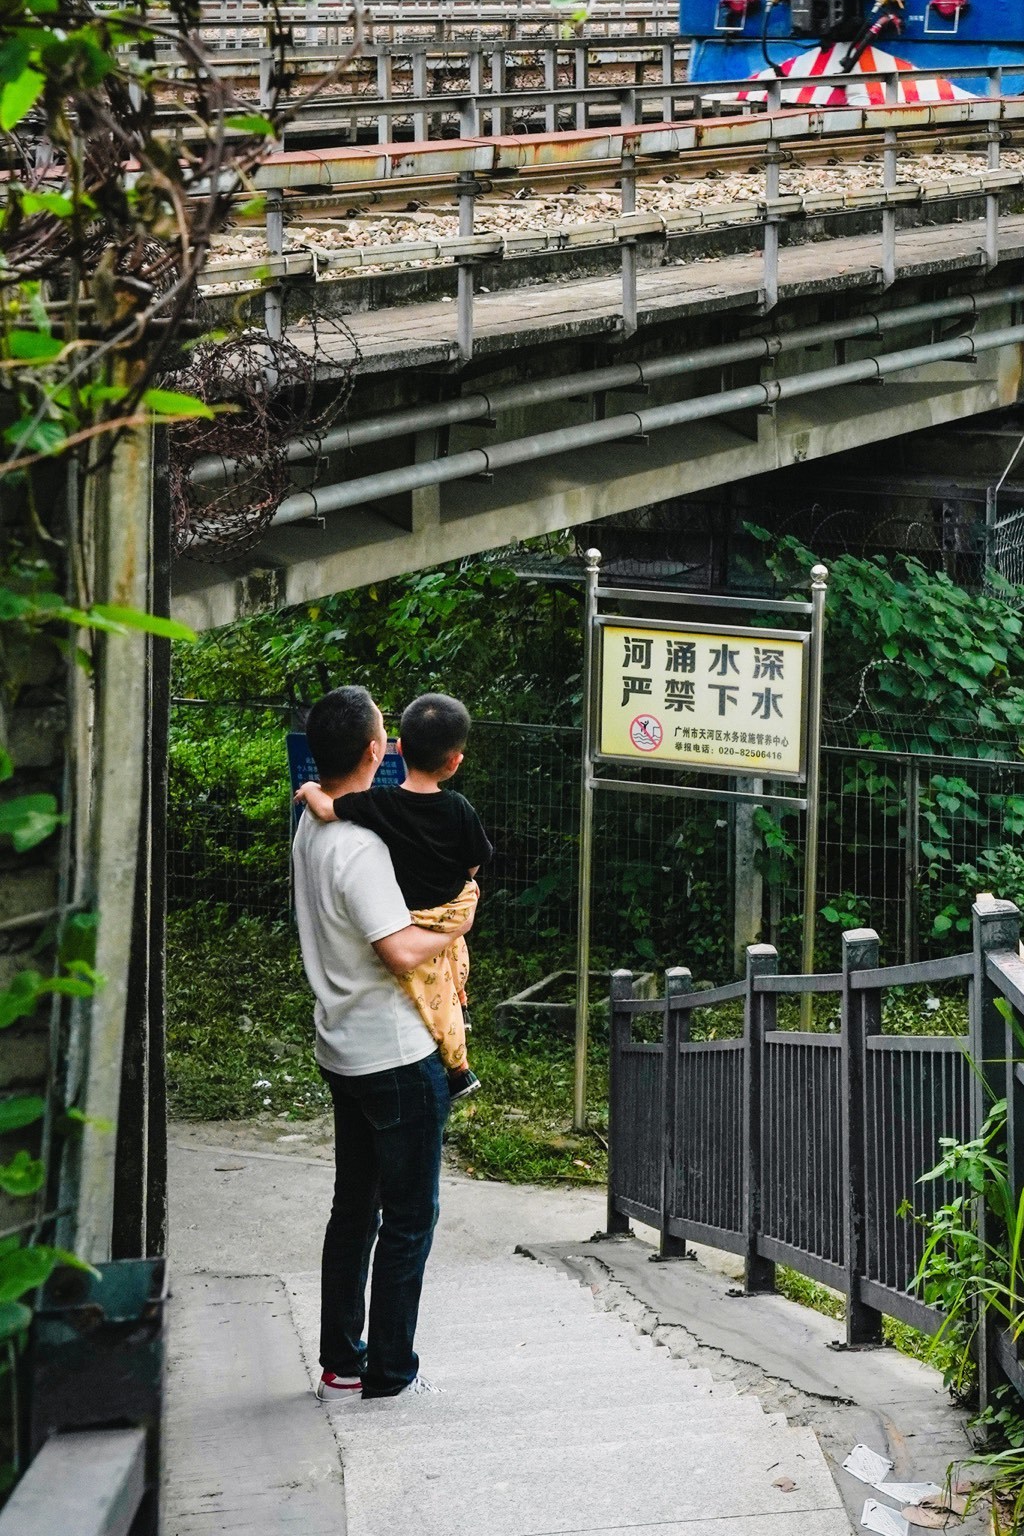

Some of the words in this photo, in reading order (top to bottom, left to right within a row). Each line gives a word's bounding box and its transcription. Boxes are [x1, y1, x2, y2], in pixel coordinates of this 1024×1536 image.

[622, 636, 785, 681] 河涌水深
[621, 676, 784, 720] 严禁下水
[674, 726, 790, 748] 广州市天河区水务设施管养中心
